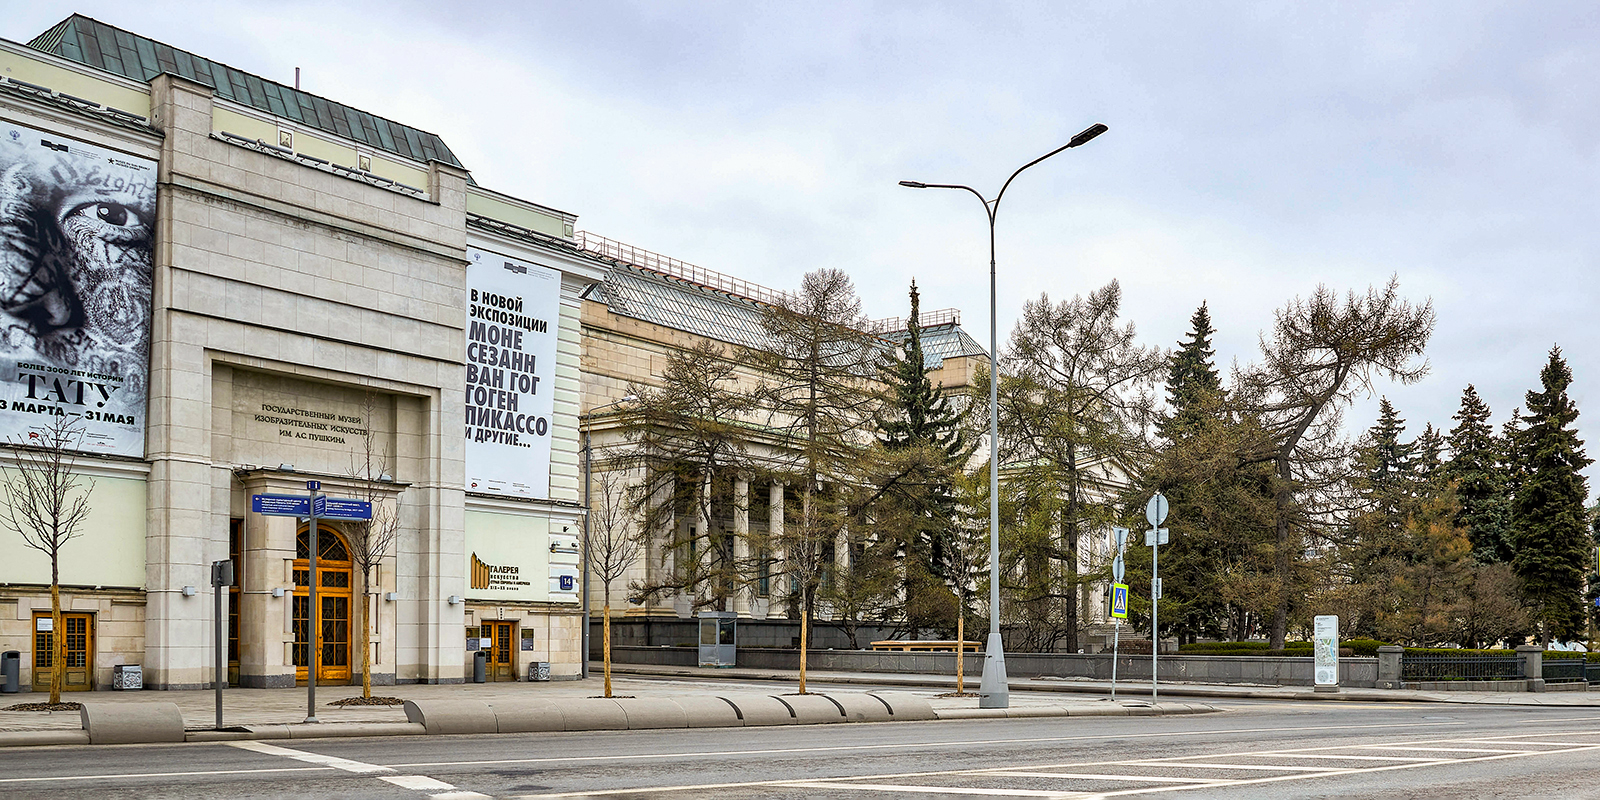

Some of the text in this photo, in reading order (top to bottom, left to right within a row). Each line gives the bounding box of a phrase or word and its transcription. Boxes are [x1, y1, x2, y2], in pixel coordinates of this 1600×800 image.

[471, 288, 523, 313] В НОВОЙ
[470, 304, 547, 333] ЭКСПОЗИЦИИ
[468, 320, 523, 350] МОНЕ
[467, 342, 536, 374] СЕЗАНН
[17, 362, 124, 382] БОЛЕЕ 3000 ЛЕТ ИСТОРИИ
[466, 363, 540, 395] ВАН ГОГ
[18, 373, 121, 408] ТАТУ
[465, 384, 519, 412] ГОГЕН
[12, 401, 65, 417] МАРТА
[85, 411, 101, 421] 31
[103, 413, 135, 425] МАЯ
[254, 414, 368, 436] ИЗОБРАЗИТЕЛЬНЫХ ИСКУССТВ
[261, 404, 361, 424] ГОСУДАРСТВЕННЫЙ МУЗЕЙ
[465, 404, 548, 436] ПИКАССО
[308, 433, 346, 444] ПУШКИНА
[465, 426, 531, 448] И ДРУГИЕ...
[490, 565, 519, 574] ГАЛЕРЕЯ
[564, 577, 571, 585] 14
